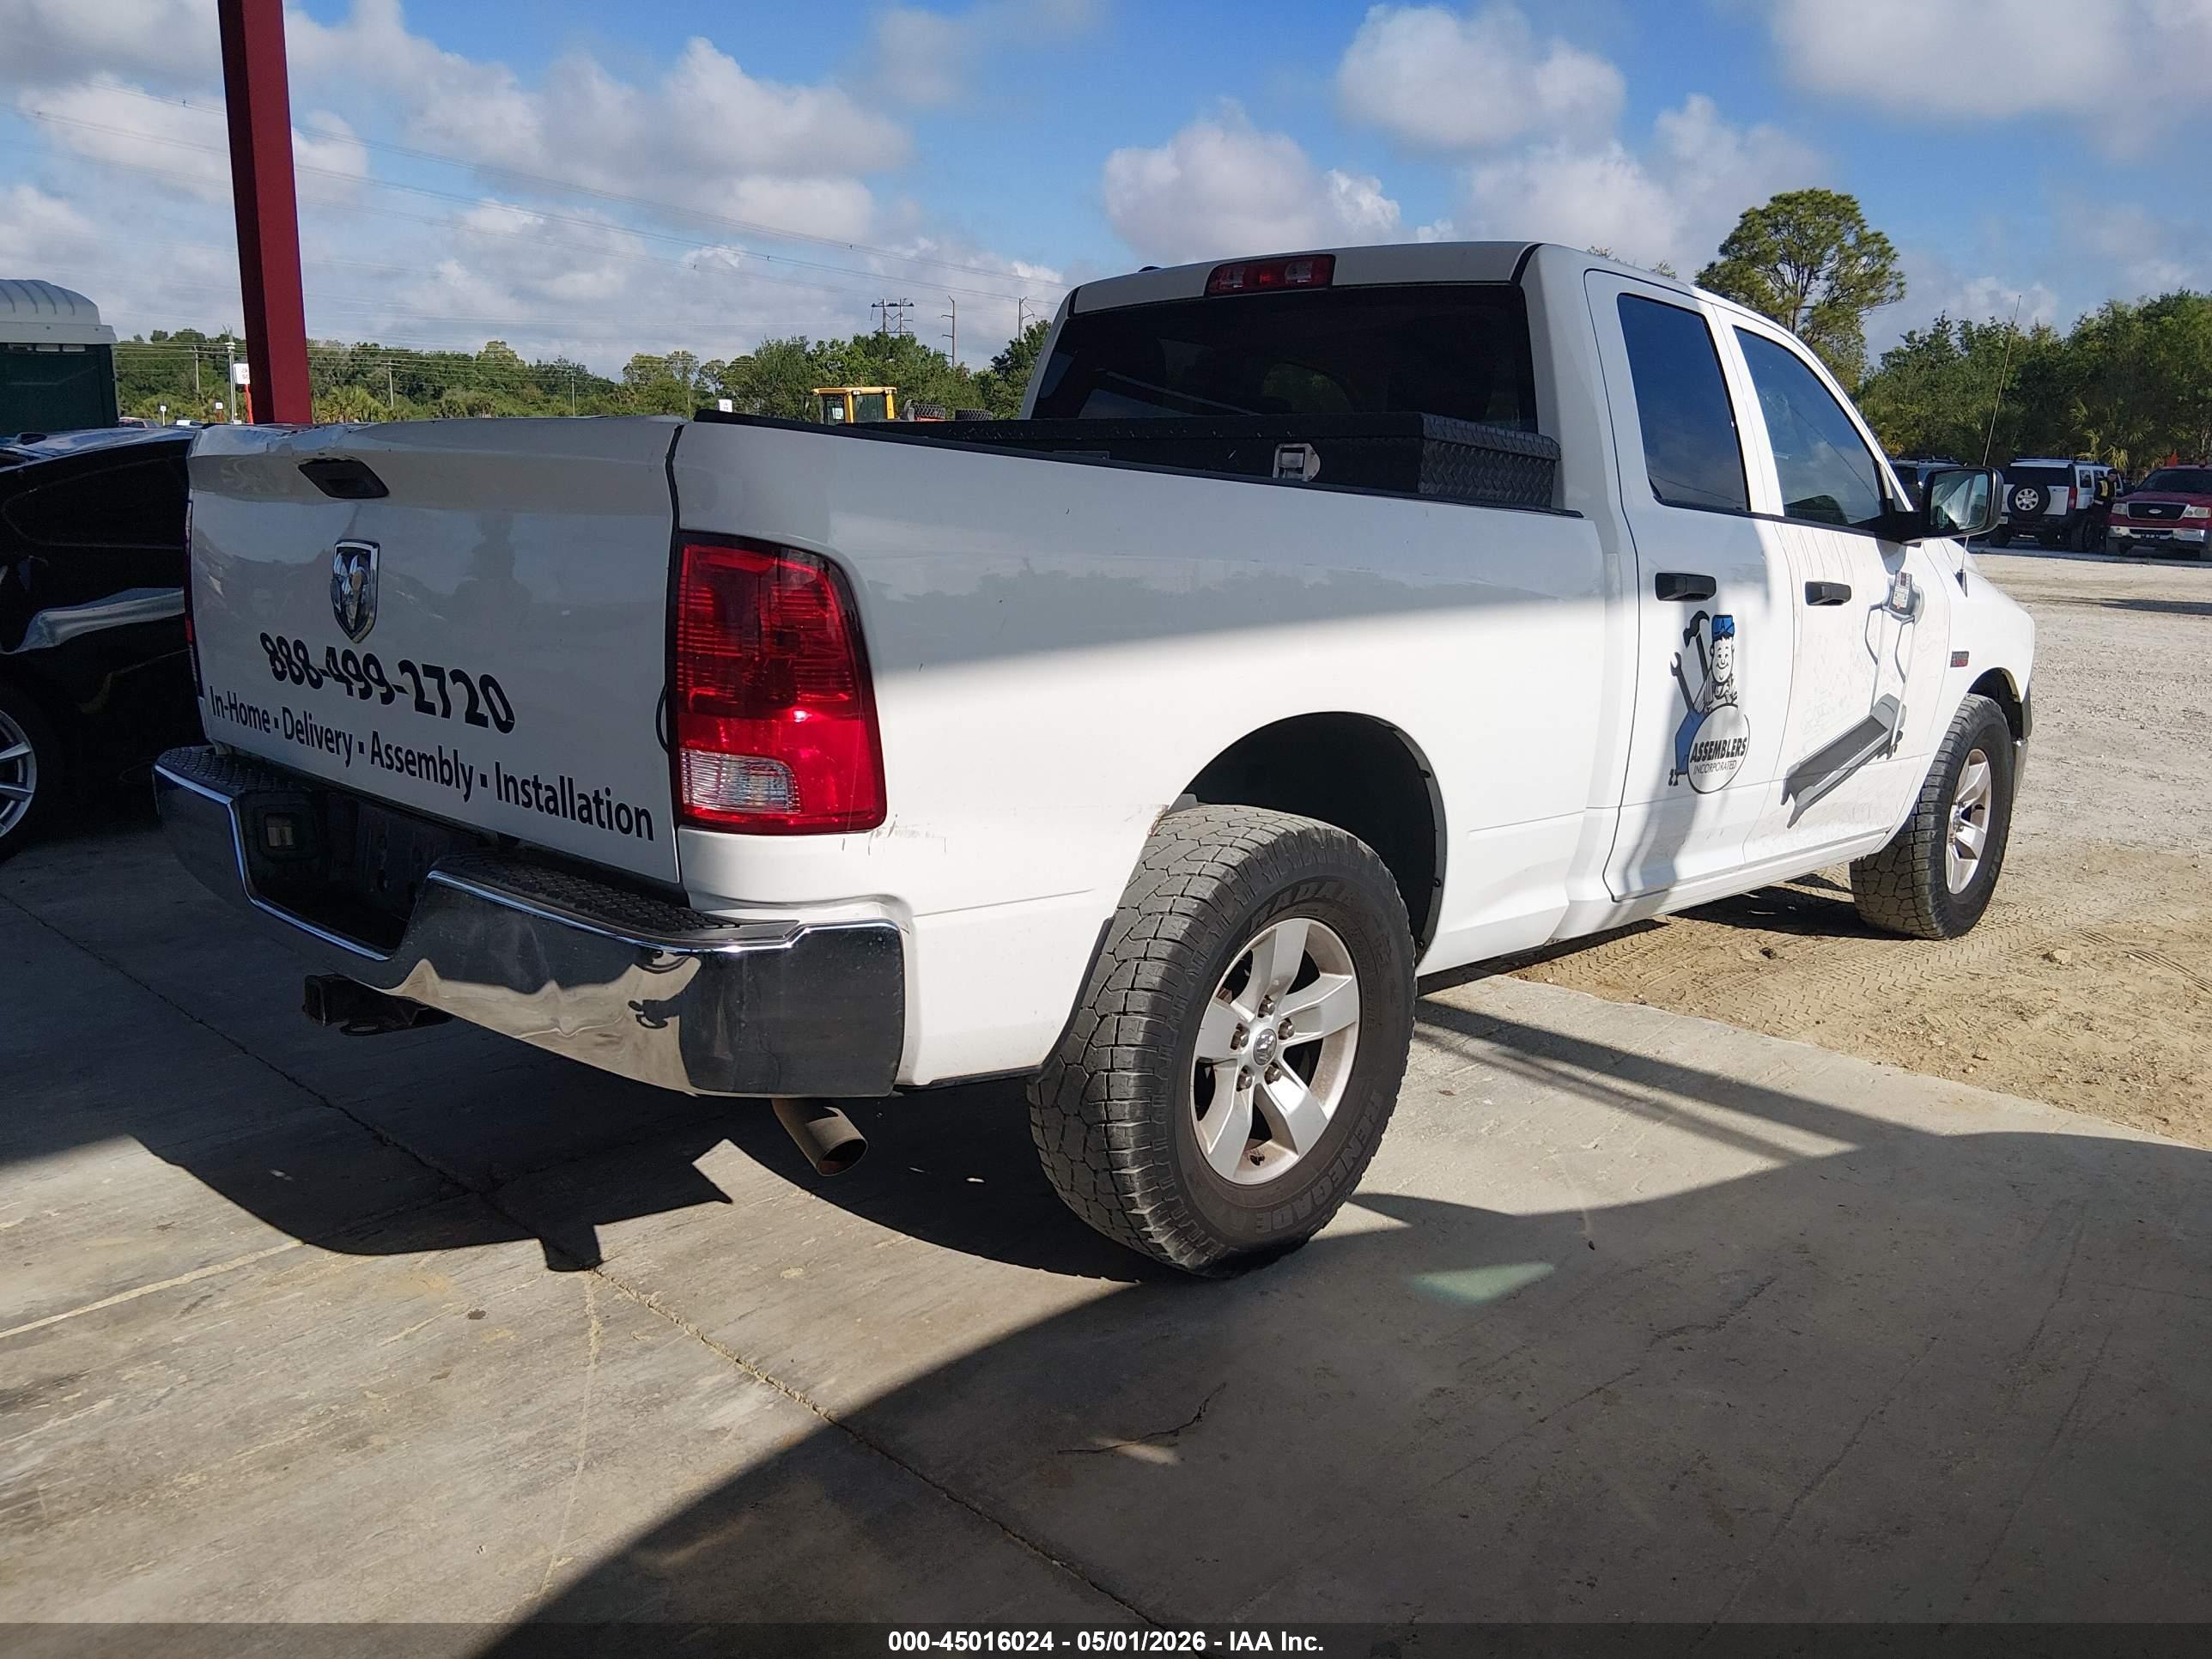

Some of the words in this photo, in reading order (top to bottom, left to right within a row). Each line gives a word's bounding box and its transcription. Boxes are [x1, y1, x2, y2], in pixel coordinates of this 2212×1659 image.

[259, 632, 515, 734] 888-499-2720
[210, 685, 271, 733] In-Home
[282, 706, 353, 768] Delivery
[370, 730, 474, 803] Assembly
[495, 761, 654, 842] Installation
[1689, 736, 1747, 763] ASSEMBLERS
[1692, 759, 1737, 775] INCORPORATED
